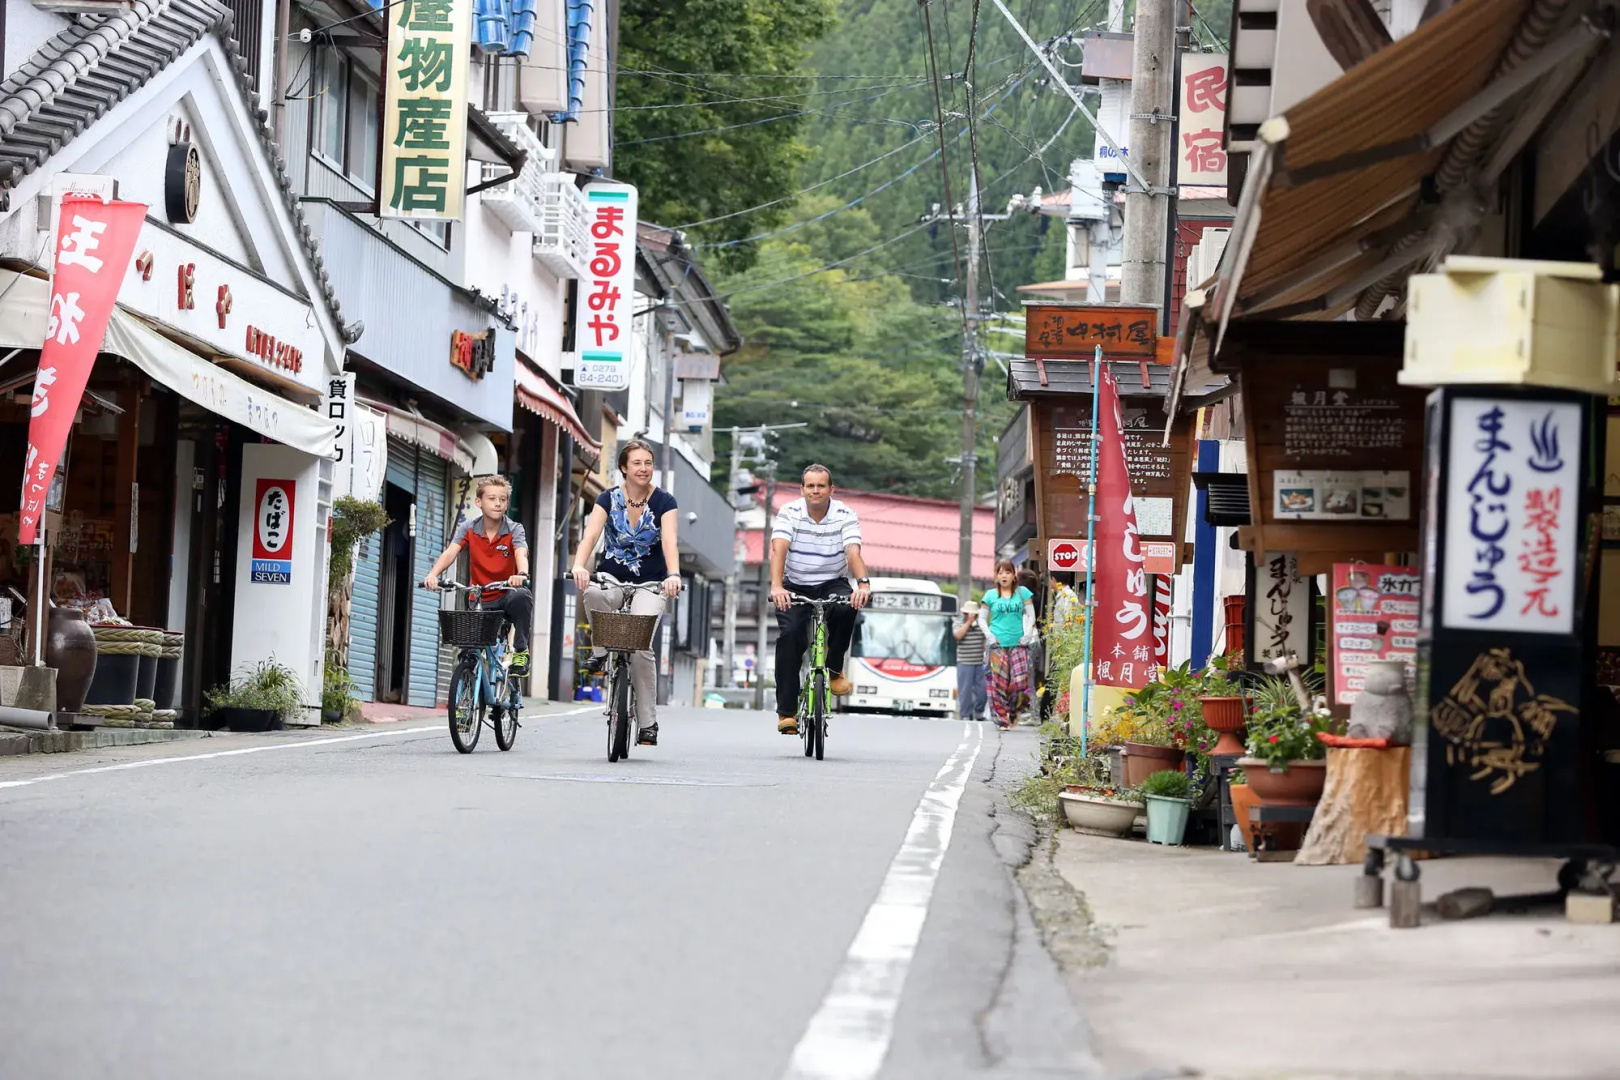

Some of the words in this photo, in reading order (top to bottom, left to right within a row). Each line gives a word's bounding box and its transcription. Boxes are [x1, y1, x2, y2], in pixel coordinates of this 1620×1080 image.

[1183, 66, 1228, 173] 民宿
[587, 206, 624, 347] まるみや
[1066, 321, 1150, 345] 中村屋
[580, 373, 624, 383] 64-2401
[592, 364, 617, 373] 0279
[266, 491, 286, 548] たばこ
[1465, 404, 1512, 620] まんじゅう
[1054, 550, 1078, 561] STOP
[1517, 486, 1562, 617] 製造元
[254, 572, 287, 582] SEVEN
[255, 562, 281, 572] MILD
[873, 595, 938, 609] 中之条駅行
[1266, 553, 1294, 648] まんじゅう
[1110, 642, 1151, 661] 本舗
